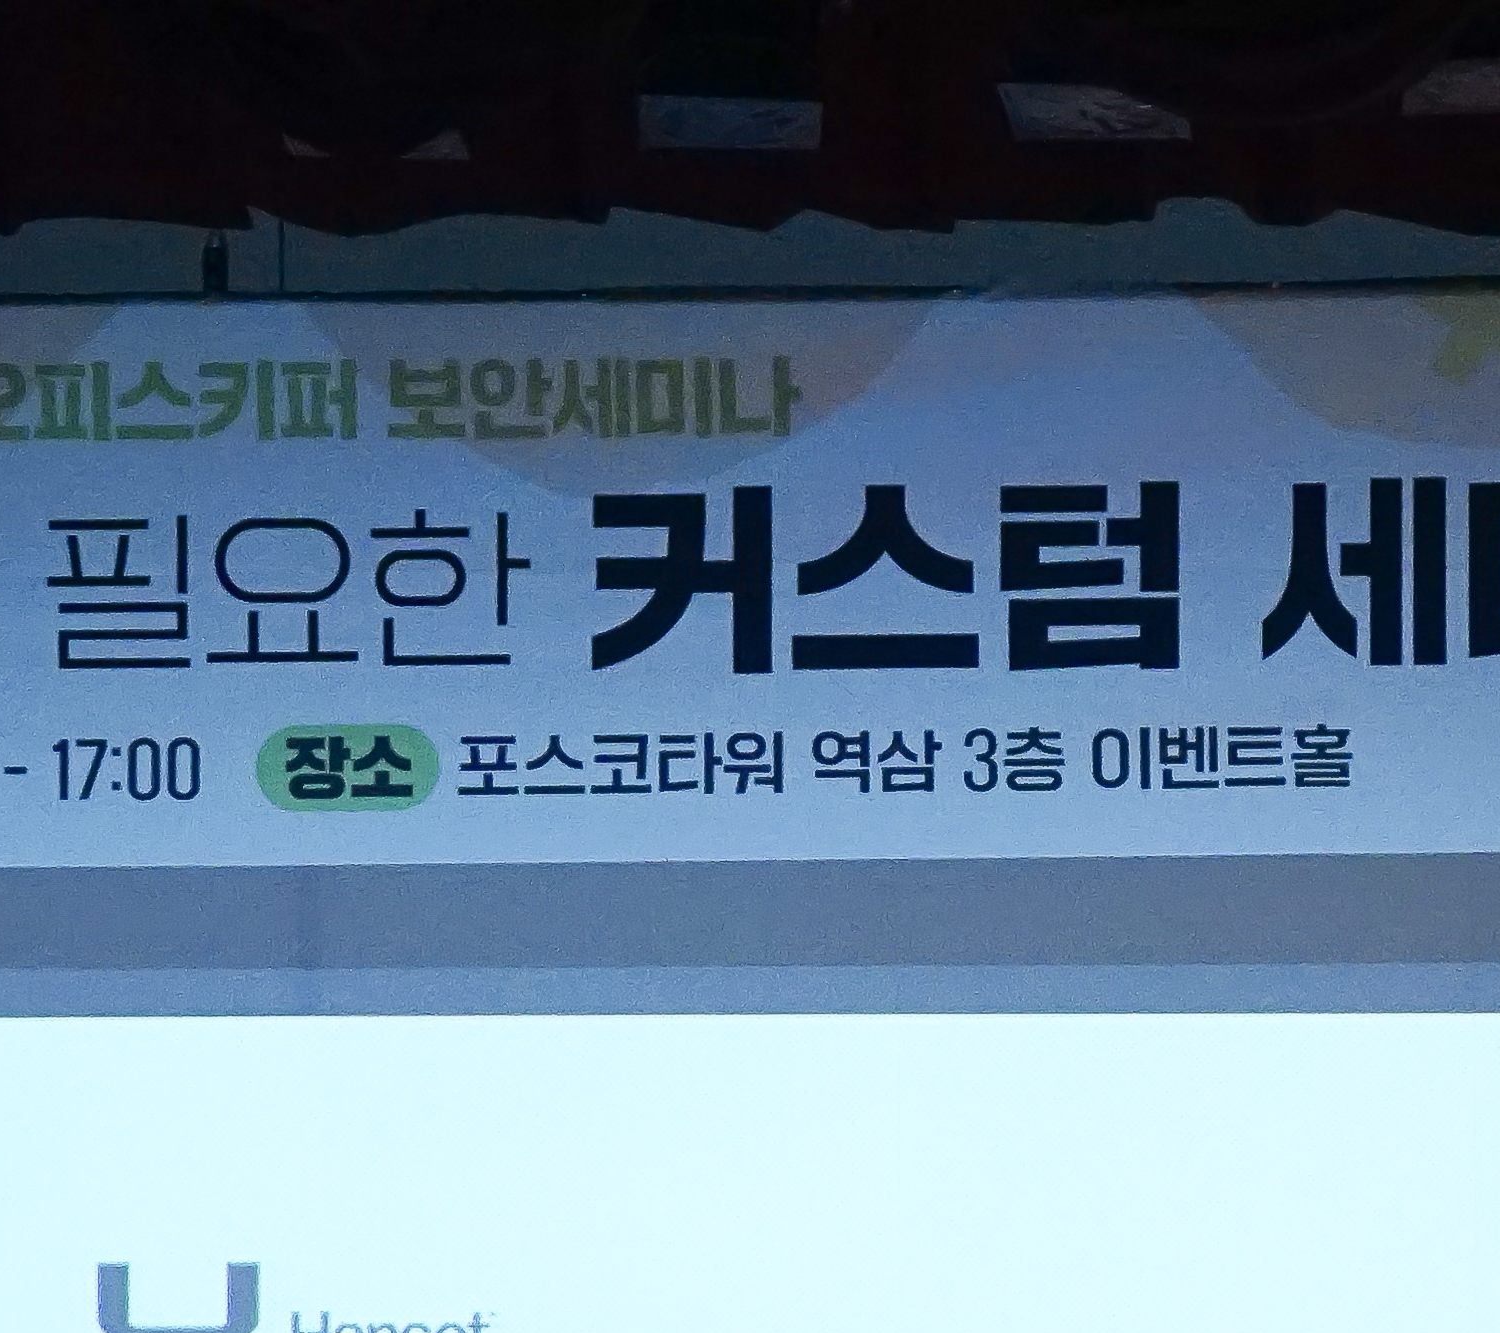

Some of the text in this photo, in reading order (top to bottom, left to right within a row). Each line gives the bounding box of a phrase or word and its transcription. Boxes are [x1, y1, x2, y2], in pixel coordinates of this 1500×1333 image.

[388, 356, 801, 439] 보안세미나
[47, 509, 531, 669] 필요한
[592, 481, 1180, 674] 커스텀
[53, 738, 200, 801] 17:00
[286, 736, 413, 799] 장소
[458, 732, 783, 795] 포스코타워
[812, 730, 942, 793] 역삼
[964, 727, 1065, 792] 3층
[1092, 724, 1352, 789] 이벤트홀
